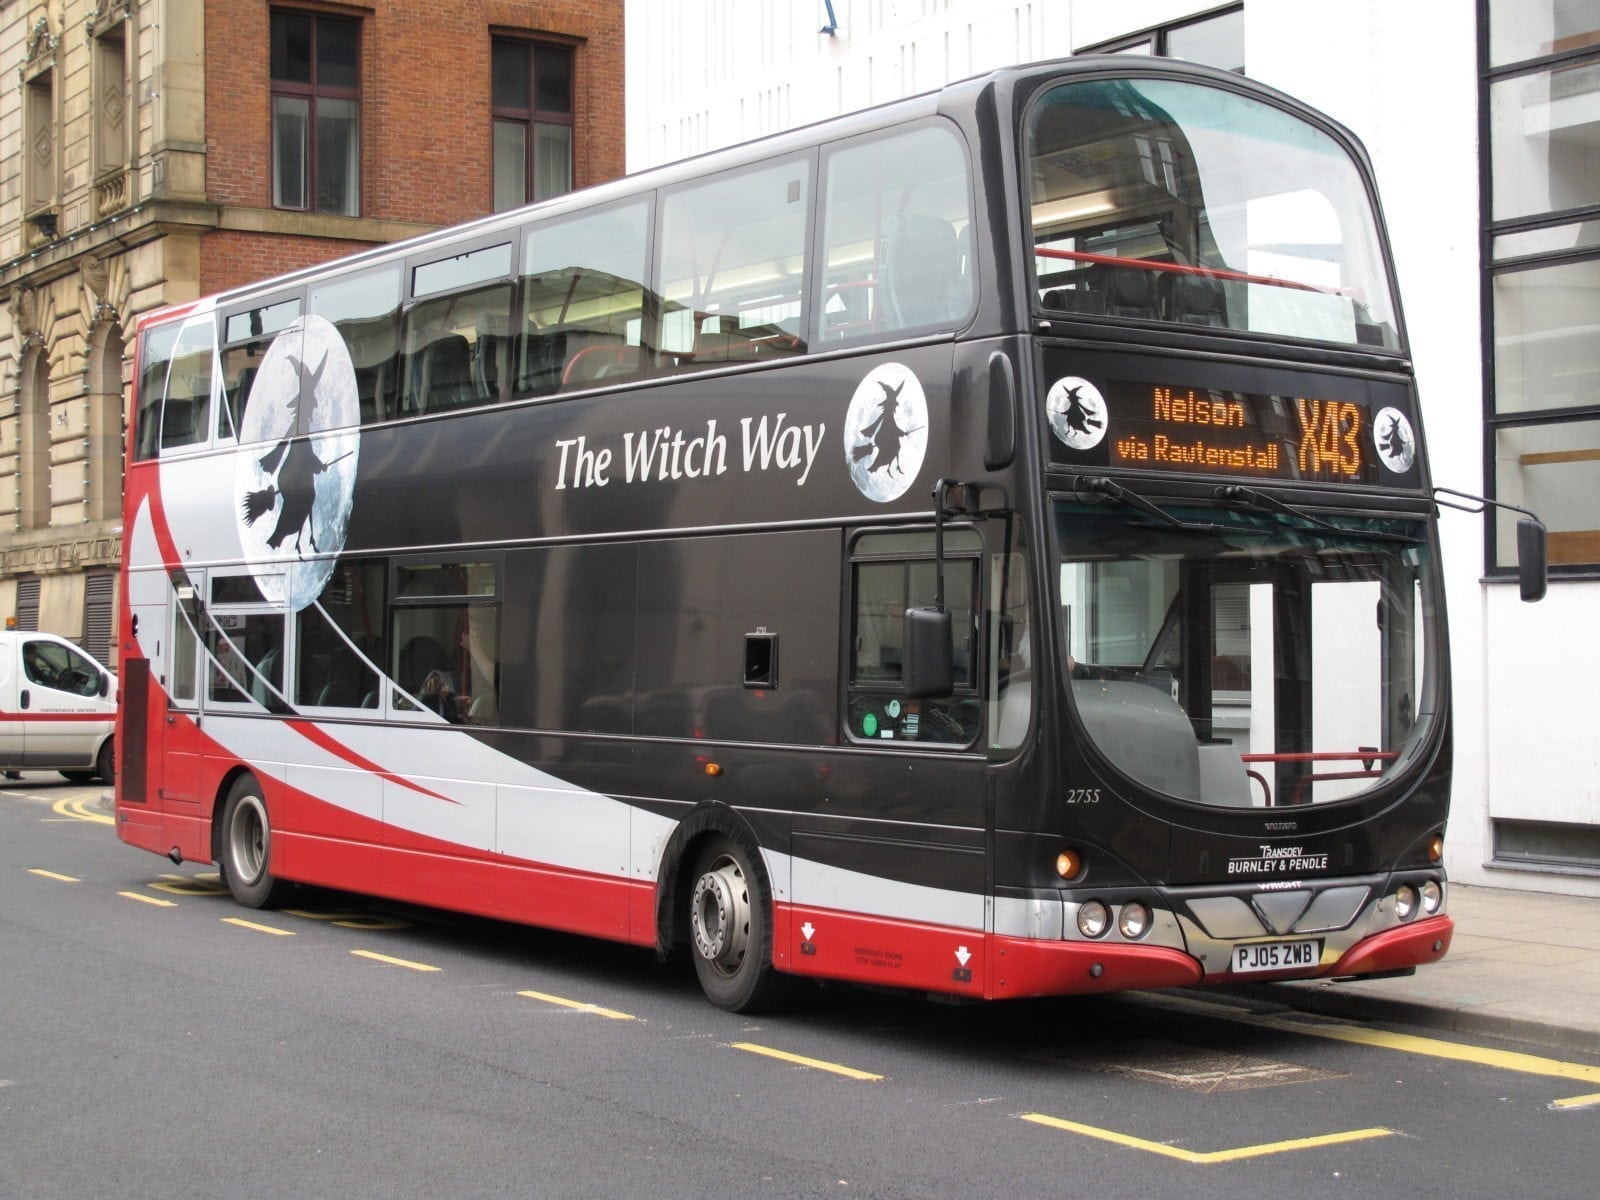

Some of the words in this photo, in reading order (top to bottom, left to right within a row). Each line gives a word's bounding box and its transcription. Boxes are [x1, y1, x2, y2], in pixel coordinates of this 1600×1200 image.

[1154, 388, 1244, 427] Nelson
[1298, 398, 1361, 475] X43
[555, 435, 612, 490] The
[623, 419, 727, 484] Witch
[740, 412, 826, 486] Way
[1117, 436, 1148, 460] via
[1154, 434, 1278, 470] Rawtenstall
[1067, 789, 1101, 804] 2755
[1259, 845, 1303, 859] TRANSDEV
[1228, 860, 1277, 874] BURNLEY
[1279, 861, 1286, 871] &
[1289, 857, 1328, 870] PENDLE
[1257, 881, 1303, 890] WRIGHT
[1239, 946, 1279, 968] PJ05
[1282, 944, 1312, 965] ZWB
